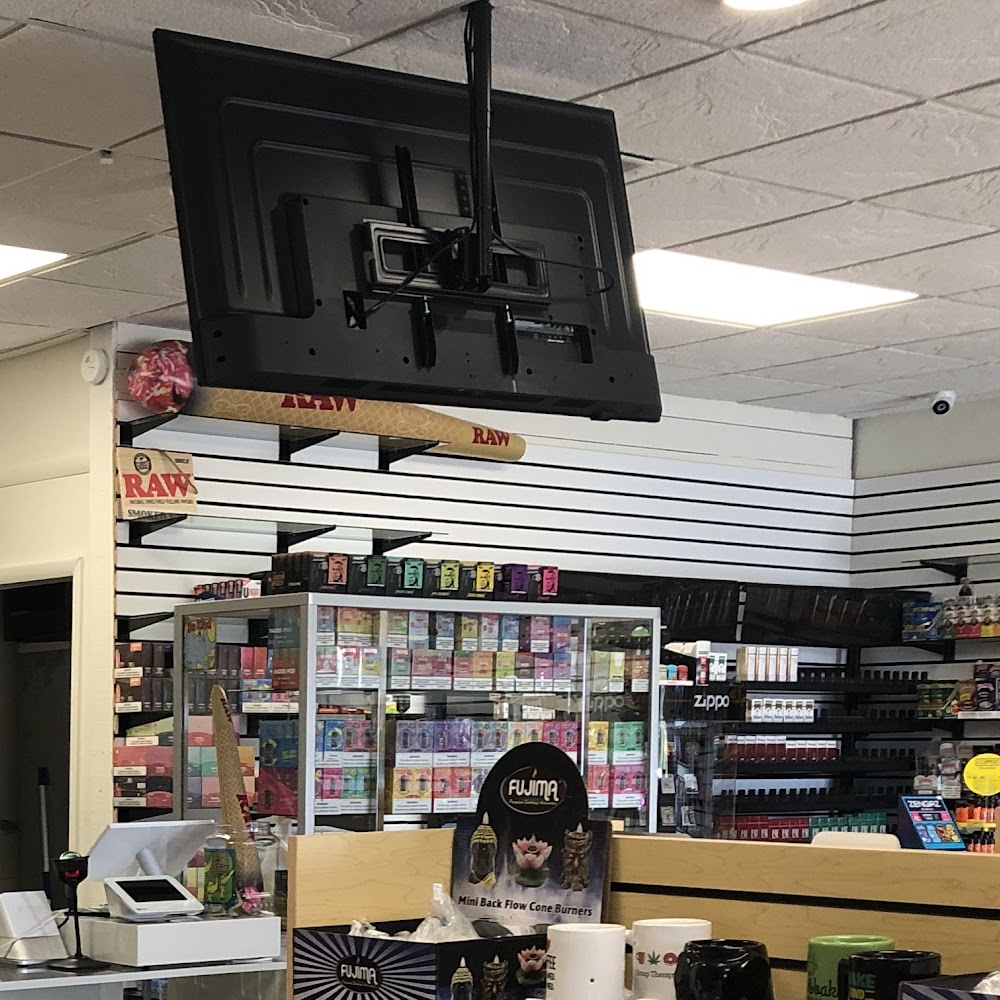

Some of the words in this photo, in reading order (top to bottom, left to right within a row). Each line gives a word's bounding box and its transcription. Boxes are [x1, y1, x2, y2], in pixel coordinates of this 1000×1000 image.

[472, 426, 510, 447] RAW
[122, 473, 191, 498] RAW
[508, 779, 560, 802] FUJIMA
[458, 895, 478, 907] Mini
[480, 897, 501, 908] Back
[504, 899, 527, 911] Flow
[529, 901, 553, 912] Cone
[555, 903, 593, 916] Burners
[340, 964, 378, 986] FUJIMA
